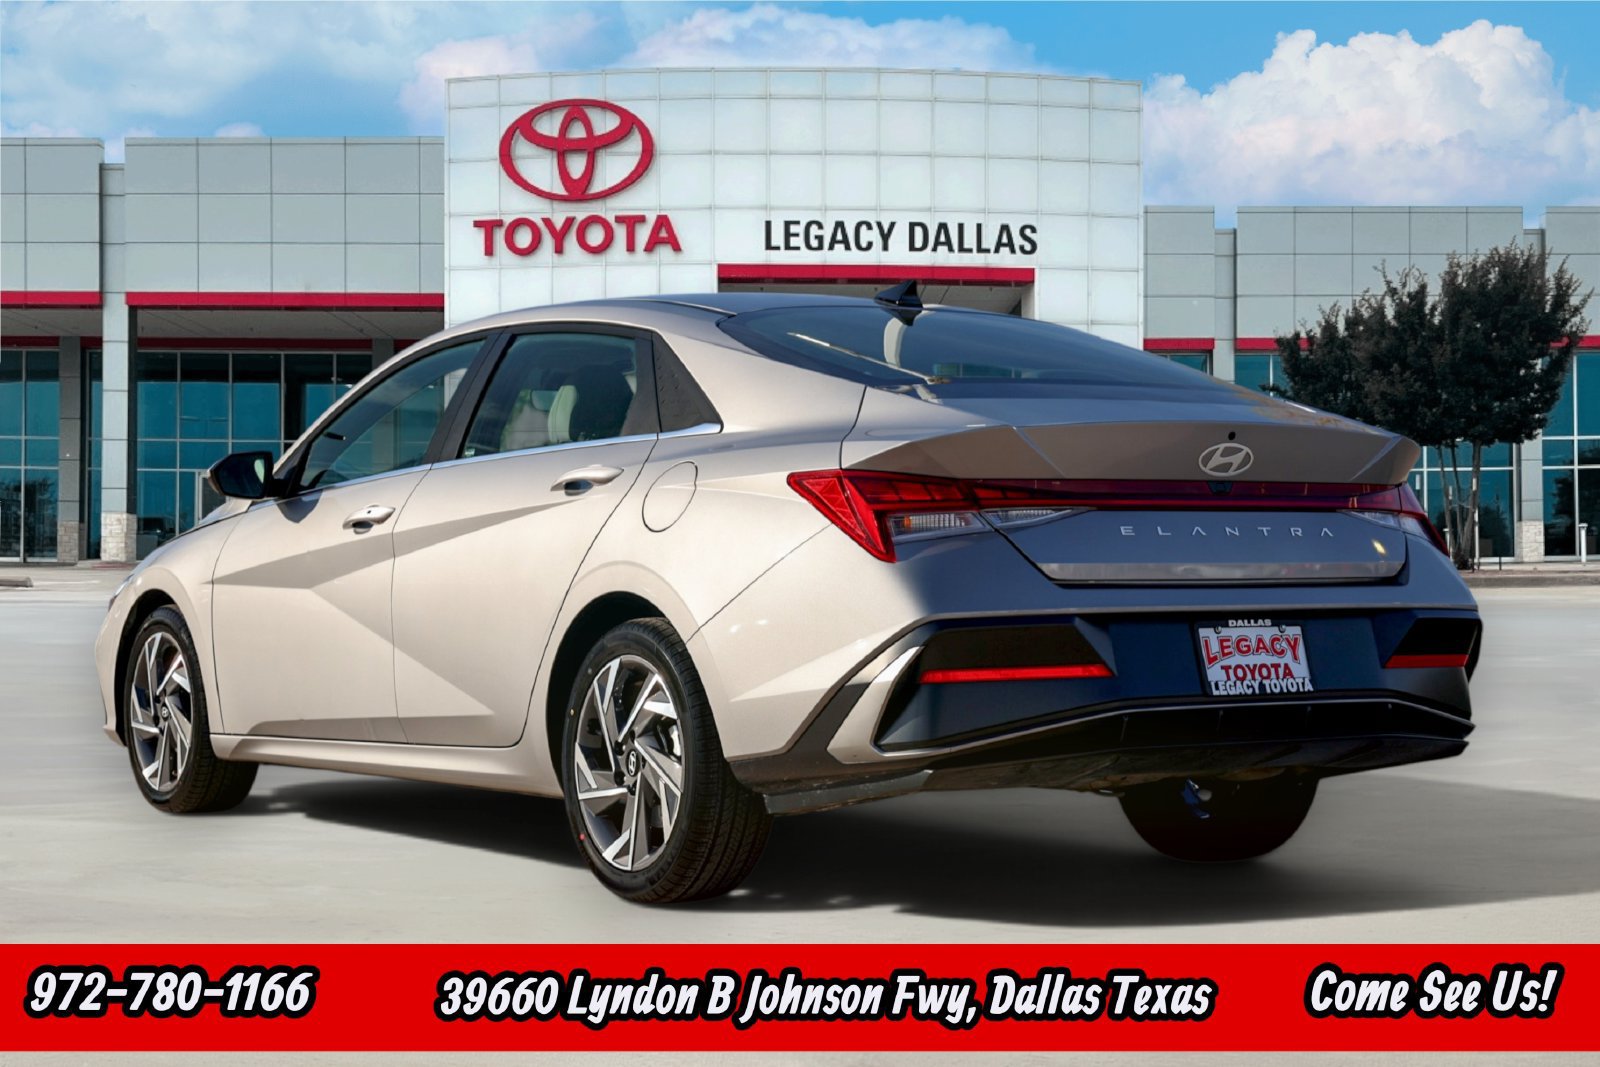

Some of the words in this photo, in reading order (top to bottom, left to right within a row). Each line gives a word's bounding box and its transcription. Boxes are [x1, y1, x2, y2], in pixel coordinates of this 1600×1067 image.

[473, 213, 682, 257] TOYOTA
[764, 220, 897, 252] LEGACY
[908, 221, 1038, 256] DALLAS
[1119, 525, 1335, 538] ELANTRA
[1228, 619, 1272, 627] DALLAS
[1202, 634, 1301, 669] LEGACY
[1220, 662, 1294, 682] TOYOTA
[1210, 679, 1261, 696] LEGACY
[1261, 677, 1314, 694] TOYOTA
